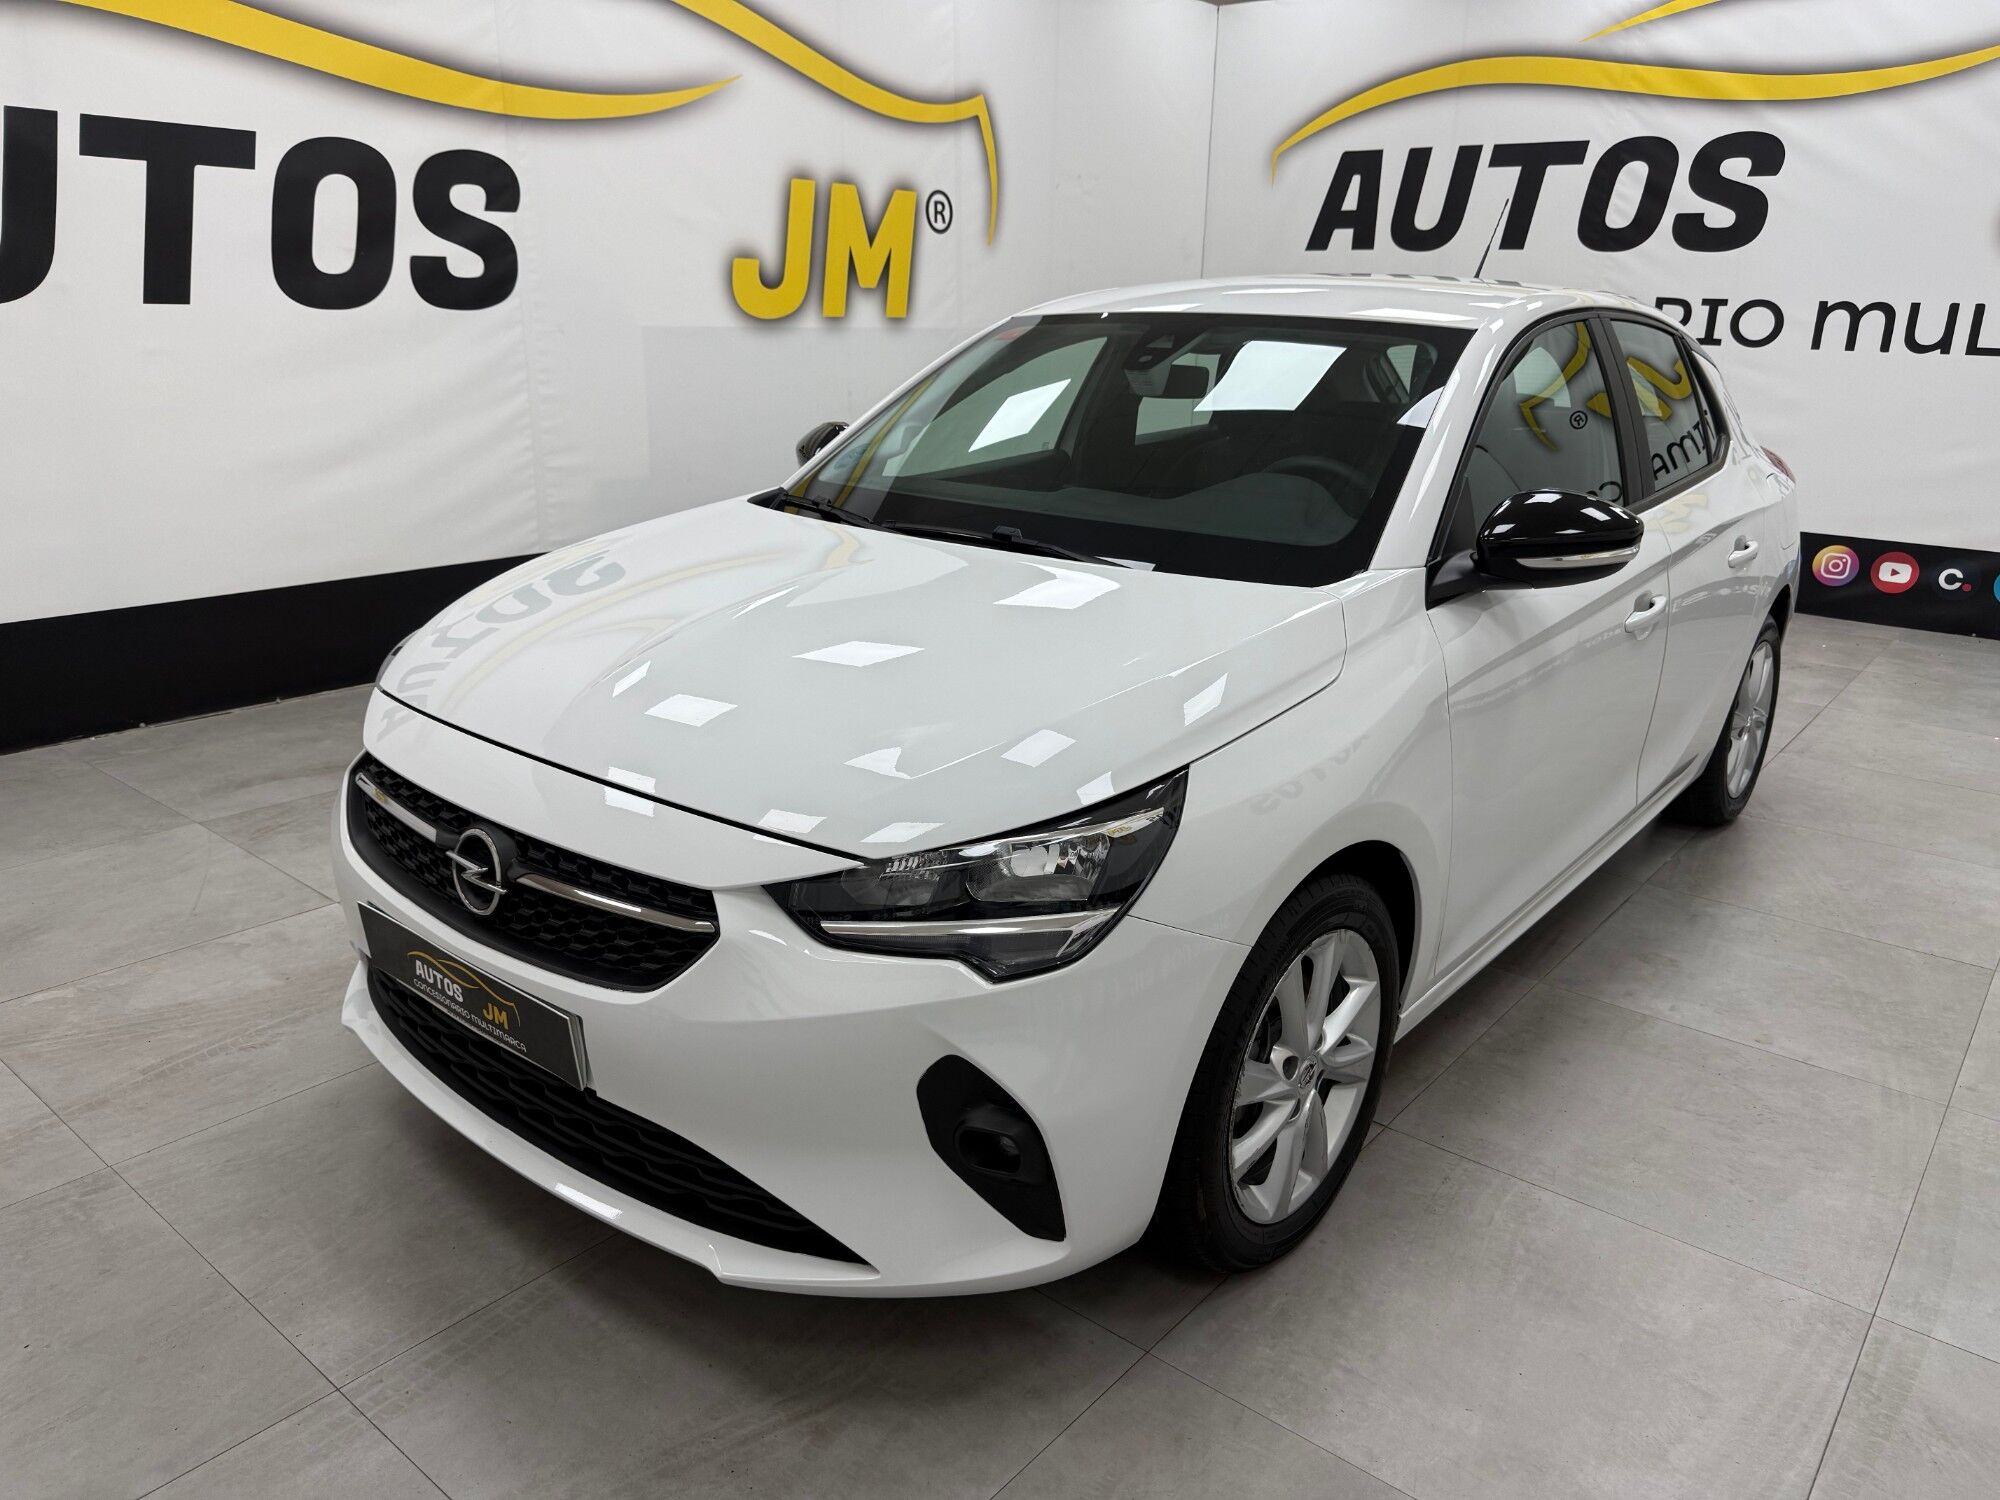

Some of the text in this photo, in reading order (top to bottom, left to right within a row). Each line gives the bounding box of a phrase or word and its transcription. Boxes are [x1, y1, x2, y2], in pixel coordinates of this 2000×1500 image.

[1304, 130, 1786, 253] AUTOS
[415, 959, 464, 1003] AUTOS
[482, 1002, 509, 1030] JM
